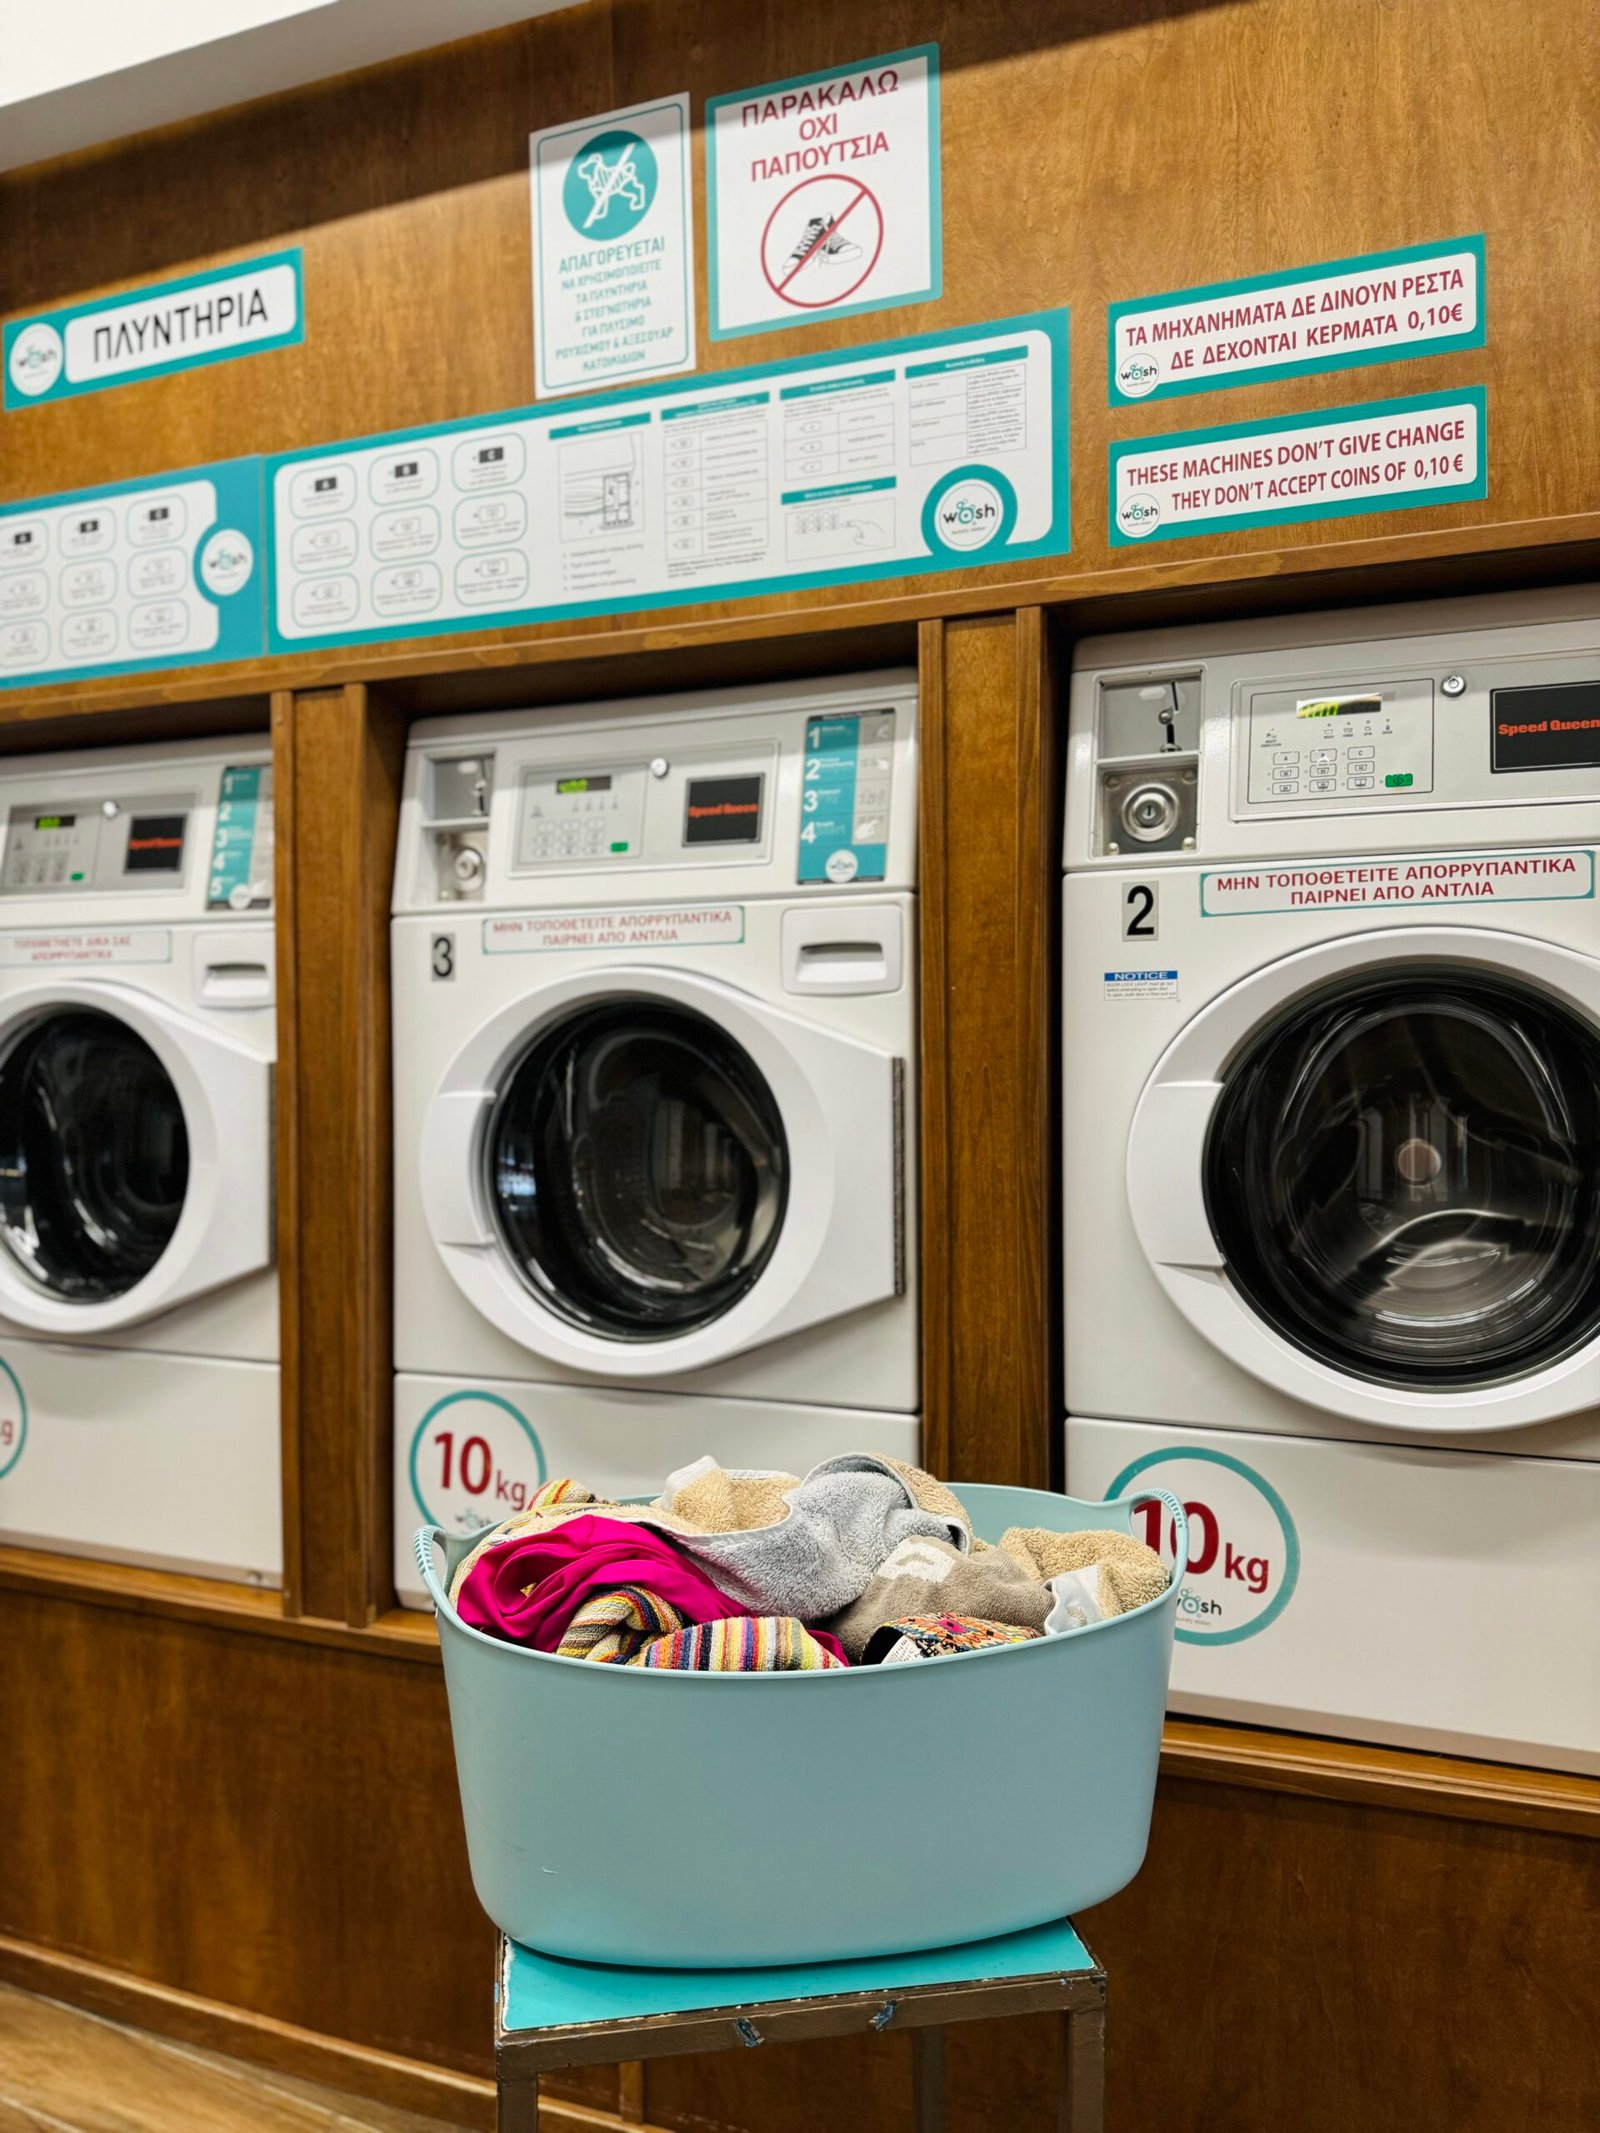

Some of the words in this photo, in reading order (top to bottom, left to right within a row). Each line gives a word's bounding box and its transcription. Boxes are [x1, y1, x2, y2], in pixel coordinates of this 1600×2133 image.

[742, 70, 899, 128] ΠΑΡΑΚΑΛΩ
[799, 113, 838, 141] ΟΧΙ
[751, 131, 890, 182] ΠΑΠΟΥΤΣΙΑ
[559, 236, 665, 274] ΑΠΑΓΟΡΕΥΕΤΑΙ
[1126, 326, 1148, 347] ΤΑ
[1152, 301, 1287, 342] ΜΗΧΑΝΗΜΑΤΑ
[1291, 295, 1316, 318] ΔΕ
[1320, 282, 1397, 312] ΔΙΝΟΥΝ
[1401, 269, 1464, 299] ΡΕΣΤΑ
[94, 288, 269, 364] ΠΛΥΝΤΗΡΙΑ
[1170, 348, 1195, 370] ΔΕ
[1202, 331, 1297, 365] ΔΕΧΟΝΤΑΙ
[1306, 314, 1398, 347] ΚΕΡΜΑΤΑ
[1407, 303, 1464, 331] 0,10€
[1127, 463, 1178, 487] THESE
[1183, 449, 1273, 479] MACHINES
[1277, 438, 1335, 466] DON'T
[1338, 432, 1381, 458] GIVE
[1385, 420, 1465, 449] CHANGE
[1171, 490, 1209, 511] THEY
[1214, 478, 1263, 505] DON'T
[1267, 471, 1327, 497] ACCEPT
[1331, 465, 1380, 489] COINS
[1384, 461, 1406, 482] OF
[808, 727, 820, 749] 1
[1498, 720, 1547, 737] Speed
[1550, 717, 1600, 732] Queen
[806, 759, 820, 780] 2
[219, 801, 231, 821] 2
[803, 790, 818, 812] 3
[800, 822, 817, 844] 4
[1217, 876, 1260, 891] ΜΗΝ
[1265, 868, 1399, 889] ΤΟΠΟΘΕΤΕΙΤΕ
[1405, 858, 1576, 882] ΑΠΟΡΡΥΠΑΝΤΙΚΑ
[1291, 888, 1366, 904] ΠΑΙΡΝΕΙ
[1372, 885, 1414, 901] ΑΠΟ
[1421, 881, 1494, 899] ΑΝΤΛΙΑ
[493, 922, 522, 934] ΜΗΝ
[527, 916, 615, 932] ΤΟΠΟΘΕΤΕΙΤΕ
[619, 911, 732, 928] ΑΠΟΡΡΥΠΑΝΤΙΚΑ
[1126, 885, 1155, 936] 2
[543, 934, 594, 946] ΠΑΙΡΝΕΙ
[597, 932, 626, 943] ΑΠΟ
[629, 930, 678, 942] ΑΝΤΛΙΑ
[433, 938, 454, 977] 3
[1115, 972, 1168, 981] NOTICE
[434, 1431, 492, 1495] 10
[1224, 1543, 1269, 1594] kg
